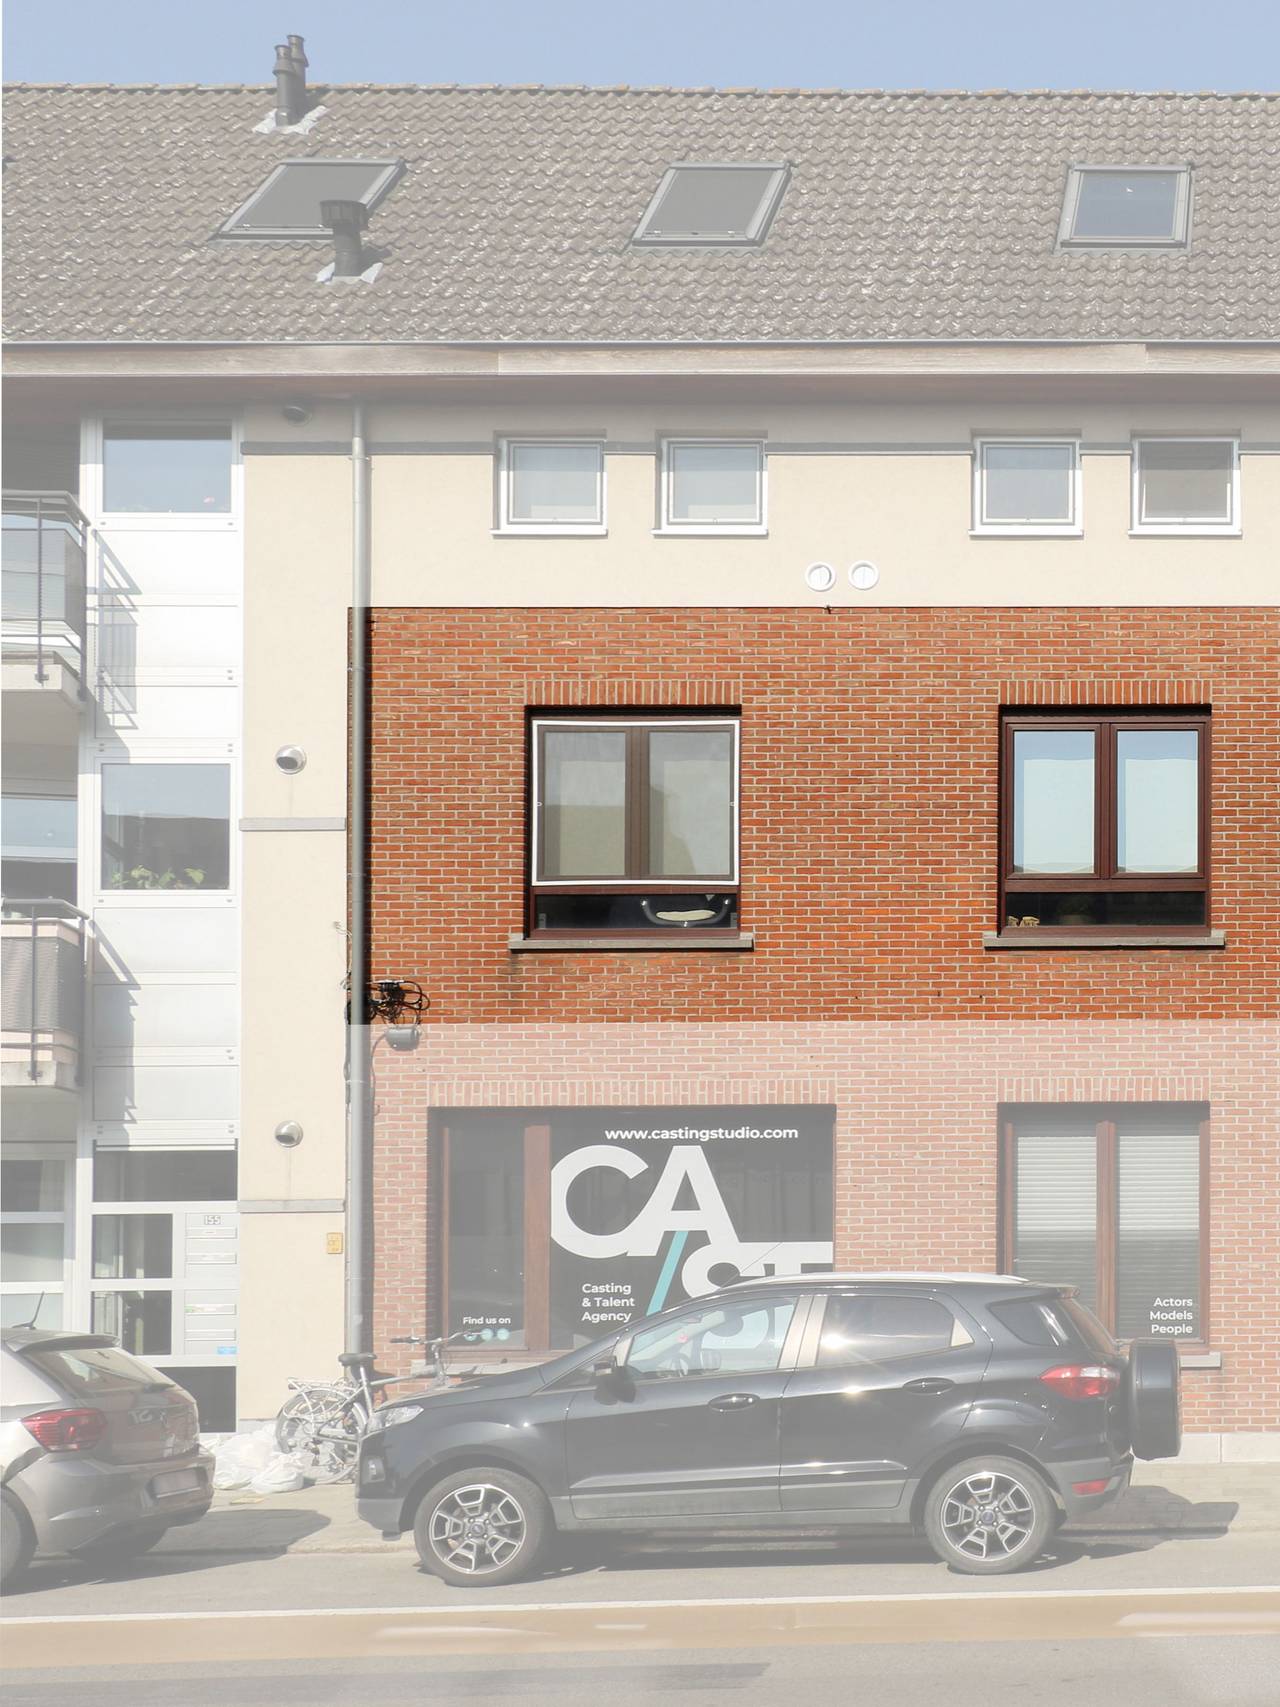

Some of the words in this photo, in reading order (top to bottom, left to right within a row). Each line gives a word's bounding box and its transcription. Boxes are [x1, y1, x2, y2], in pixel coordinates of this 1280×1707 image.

[605, 1127, 798, 1141] www.castingstudio.com
[582, 1283, 631, 1295] Casting
[582, 1298, 591, 1307] &
[594, 1297, 635, 1307] Talent
[1153, 1297, 1193, 1306] Actors
[463, 1316, 484, 1324] Find
[581, 1312, 632, 1323] Agency
[1149, 1310, 1193, 1320] Models
[1151, 1323, 1193, 1335] People
